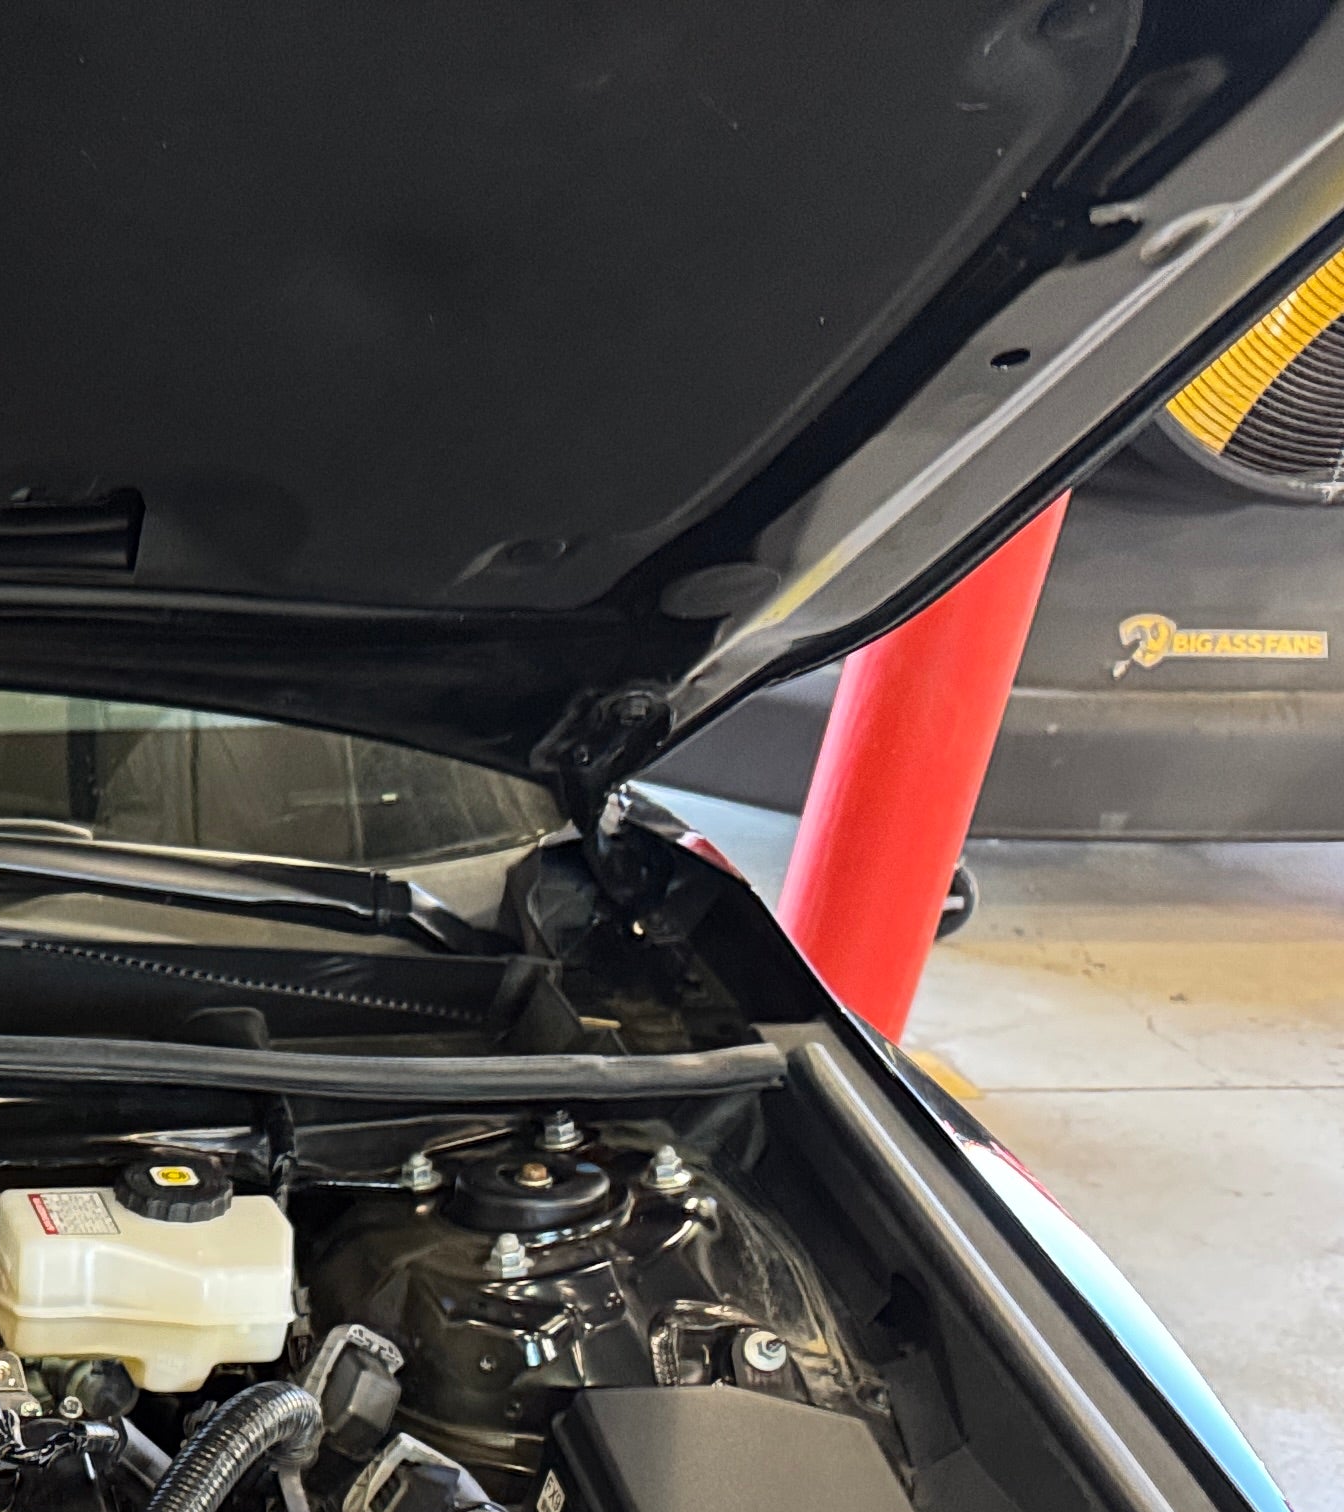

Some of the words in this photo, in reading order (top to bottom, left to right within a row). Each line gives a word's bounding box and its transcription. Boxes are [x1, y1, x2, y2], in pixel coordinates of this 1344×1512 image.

[1173, 635, 1212, 653] BIG
[1215, 635, 1262, 653] ASS
[1265, 636, 1324, 654] FANS
